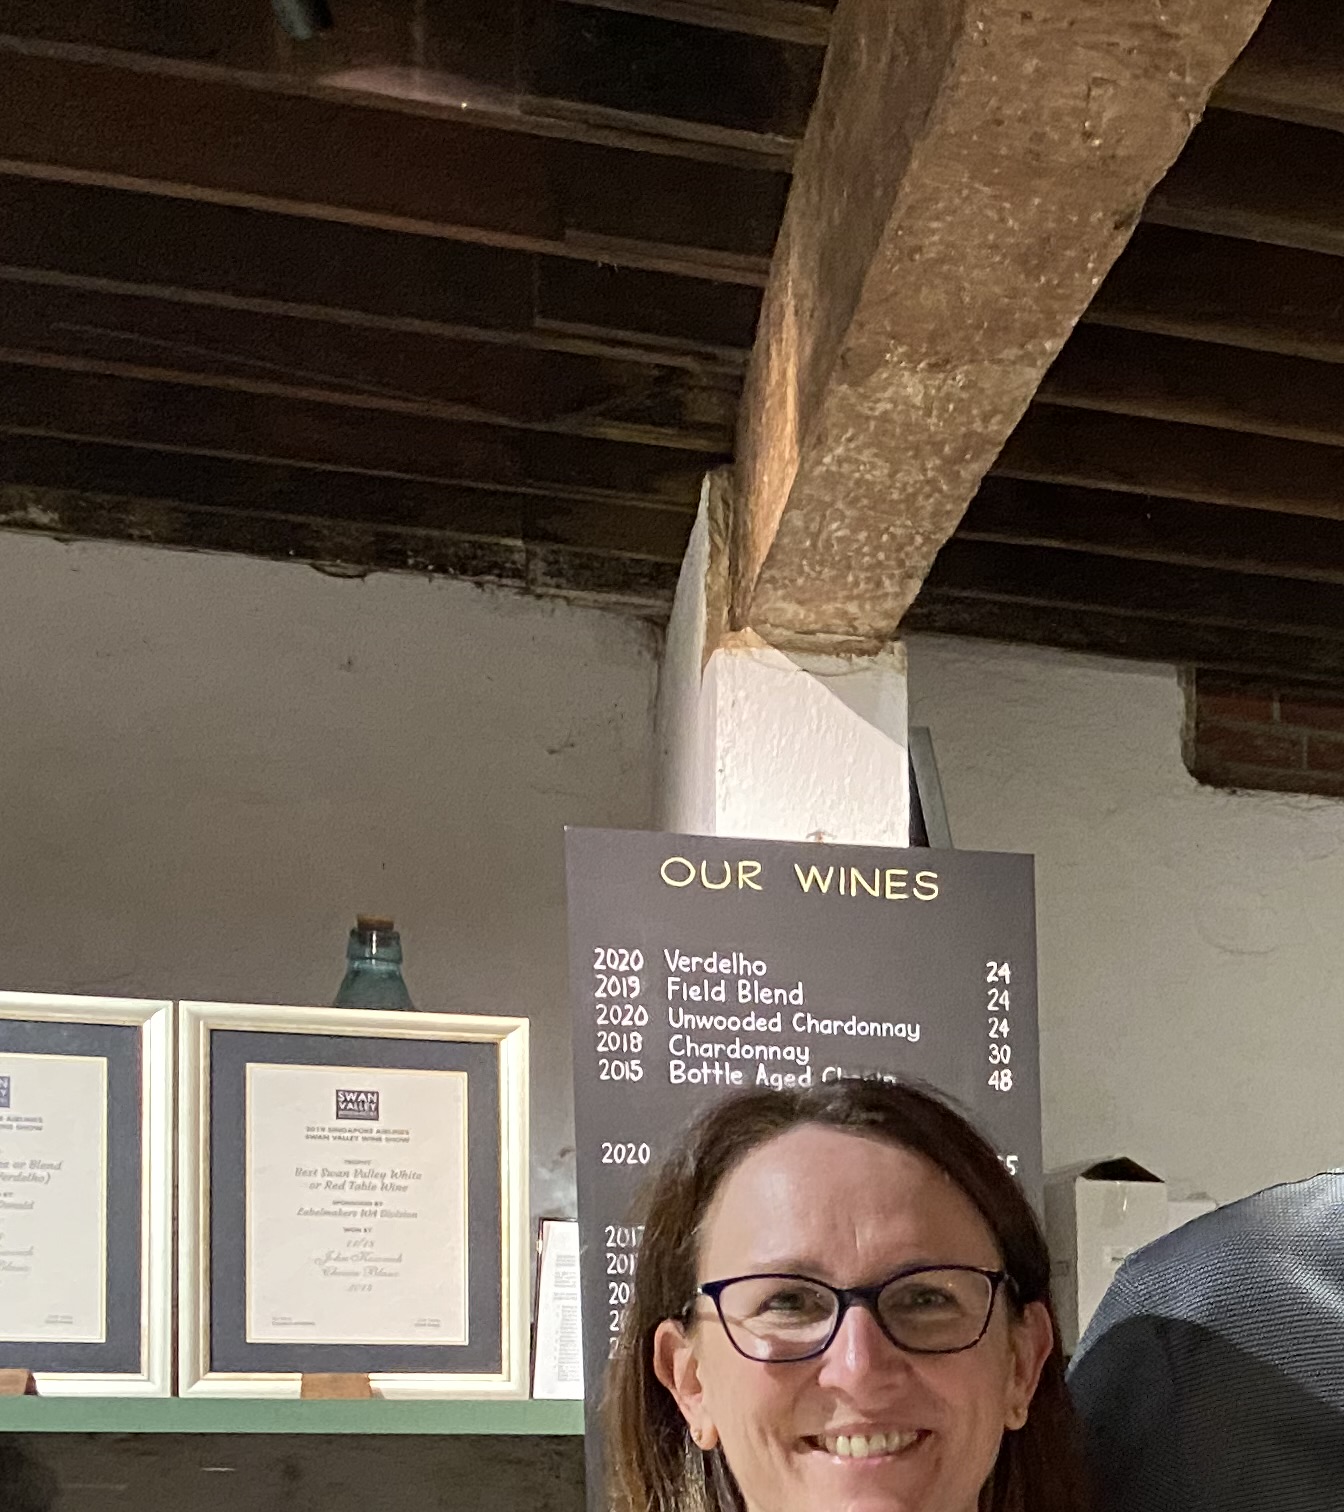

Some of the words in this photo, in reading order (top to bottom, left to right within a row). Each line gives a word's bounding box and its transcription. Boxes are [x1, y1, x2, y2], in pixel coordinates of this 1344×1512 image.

[660, 856, 763, 891] OUR
[793, 863, 940, 901] WINES
[593, 948, 645, 972] 2020
[664, 949, 768, 977] Verdelho
[985, 961, 1011, 985] 24
[594, 974, 641, 999] 2019
[668, 977, 726, 1004] Field
[738, 980, 805, 1006] Blend
[986, 988, 1010, 1012] 24
[595, 1004, 649, 1028] 2020
[668, 1006, 782, 1034] Unwooded
[792, 1012, 921, 1043] Chardonnay
[988, 1017, 1010, 1040] 24
[595, 1030, 643, 1055] 2018
[668, 1034, 811, 1066] Chardonnay
[988, 1043, 1011, 1066] 30
[597, 1058, 644, 1082] 2015
[669, 1060, 743, 1087] Bottle
[755, 1063, 813, 1092] Aged
[987, 1068, 1014, 1092] 48
[337, 1091, 378, 1103] SWAN
[338, 1102, 377, 1112] VALLEY
[332, 1135, 359, 1143] VALLEY
[295, 1167, 318, 1178] Best
[320, 1167, 349, 1179] Swan
[353, 1168, 387, 1181] Valley
[390, 1169, 423, 1181] White
[601, 1142, 651, 1165] 2020
[997, 1154, 1019, 1176] 5
[323, 1180, 346, 1191] Red
[349, 1180, 377, 1191] Table
[380, 1181, 409, 1192] Wine
[606, 1253, 637, 1275] 201
